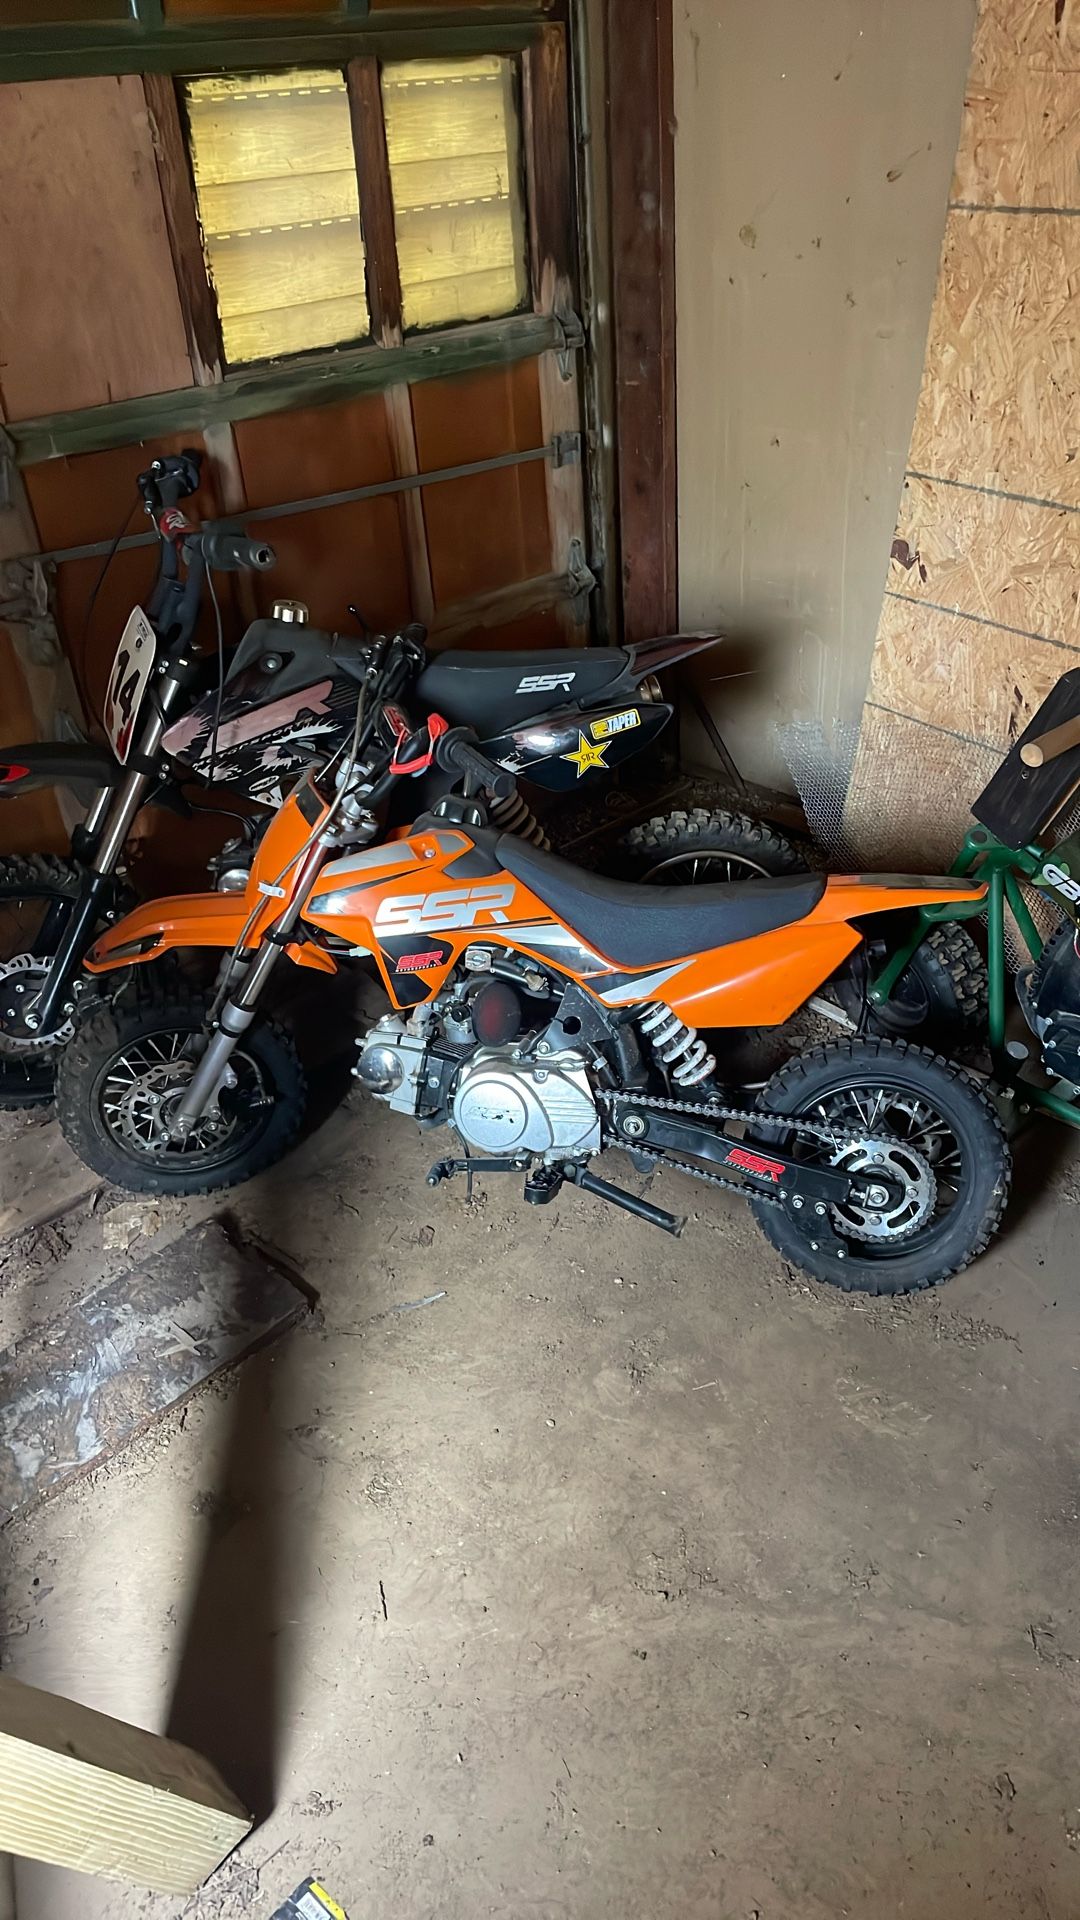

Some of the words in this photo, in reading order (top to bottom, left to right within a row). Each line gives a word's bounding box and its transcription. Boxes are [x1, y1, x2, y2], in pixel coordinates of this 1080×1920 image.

[515, 672, 576, 694] SSR
[607, 711, 637, 733] TAPER
[373, 883, 516, 938] SSR
[396, 950, 443, 970] SSR
[724, 1148, 786, 1182] SSR
